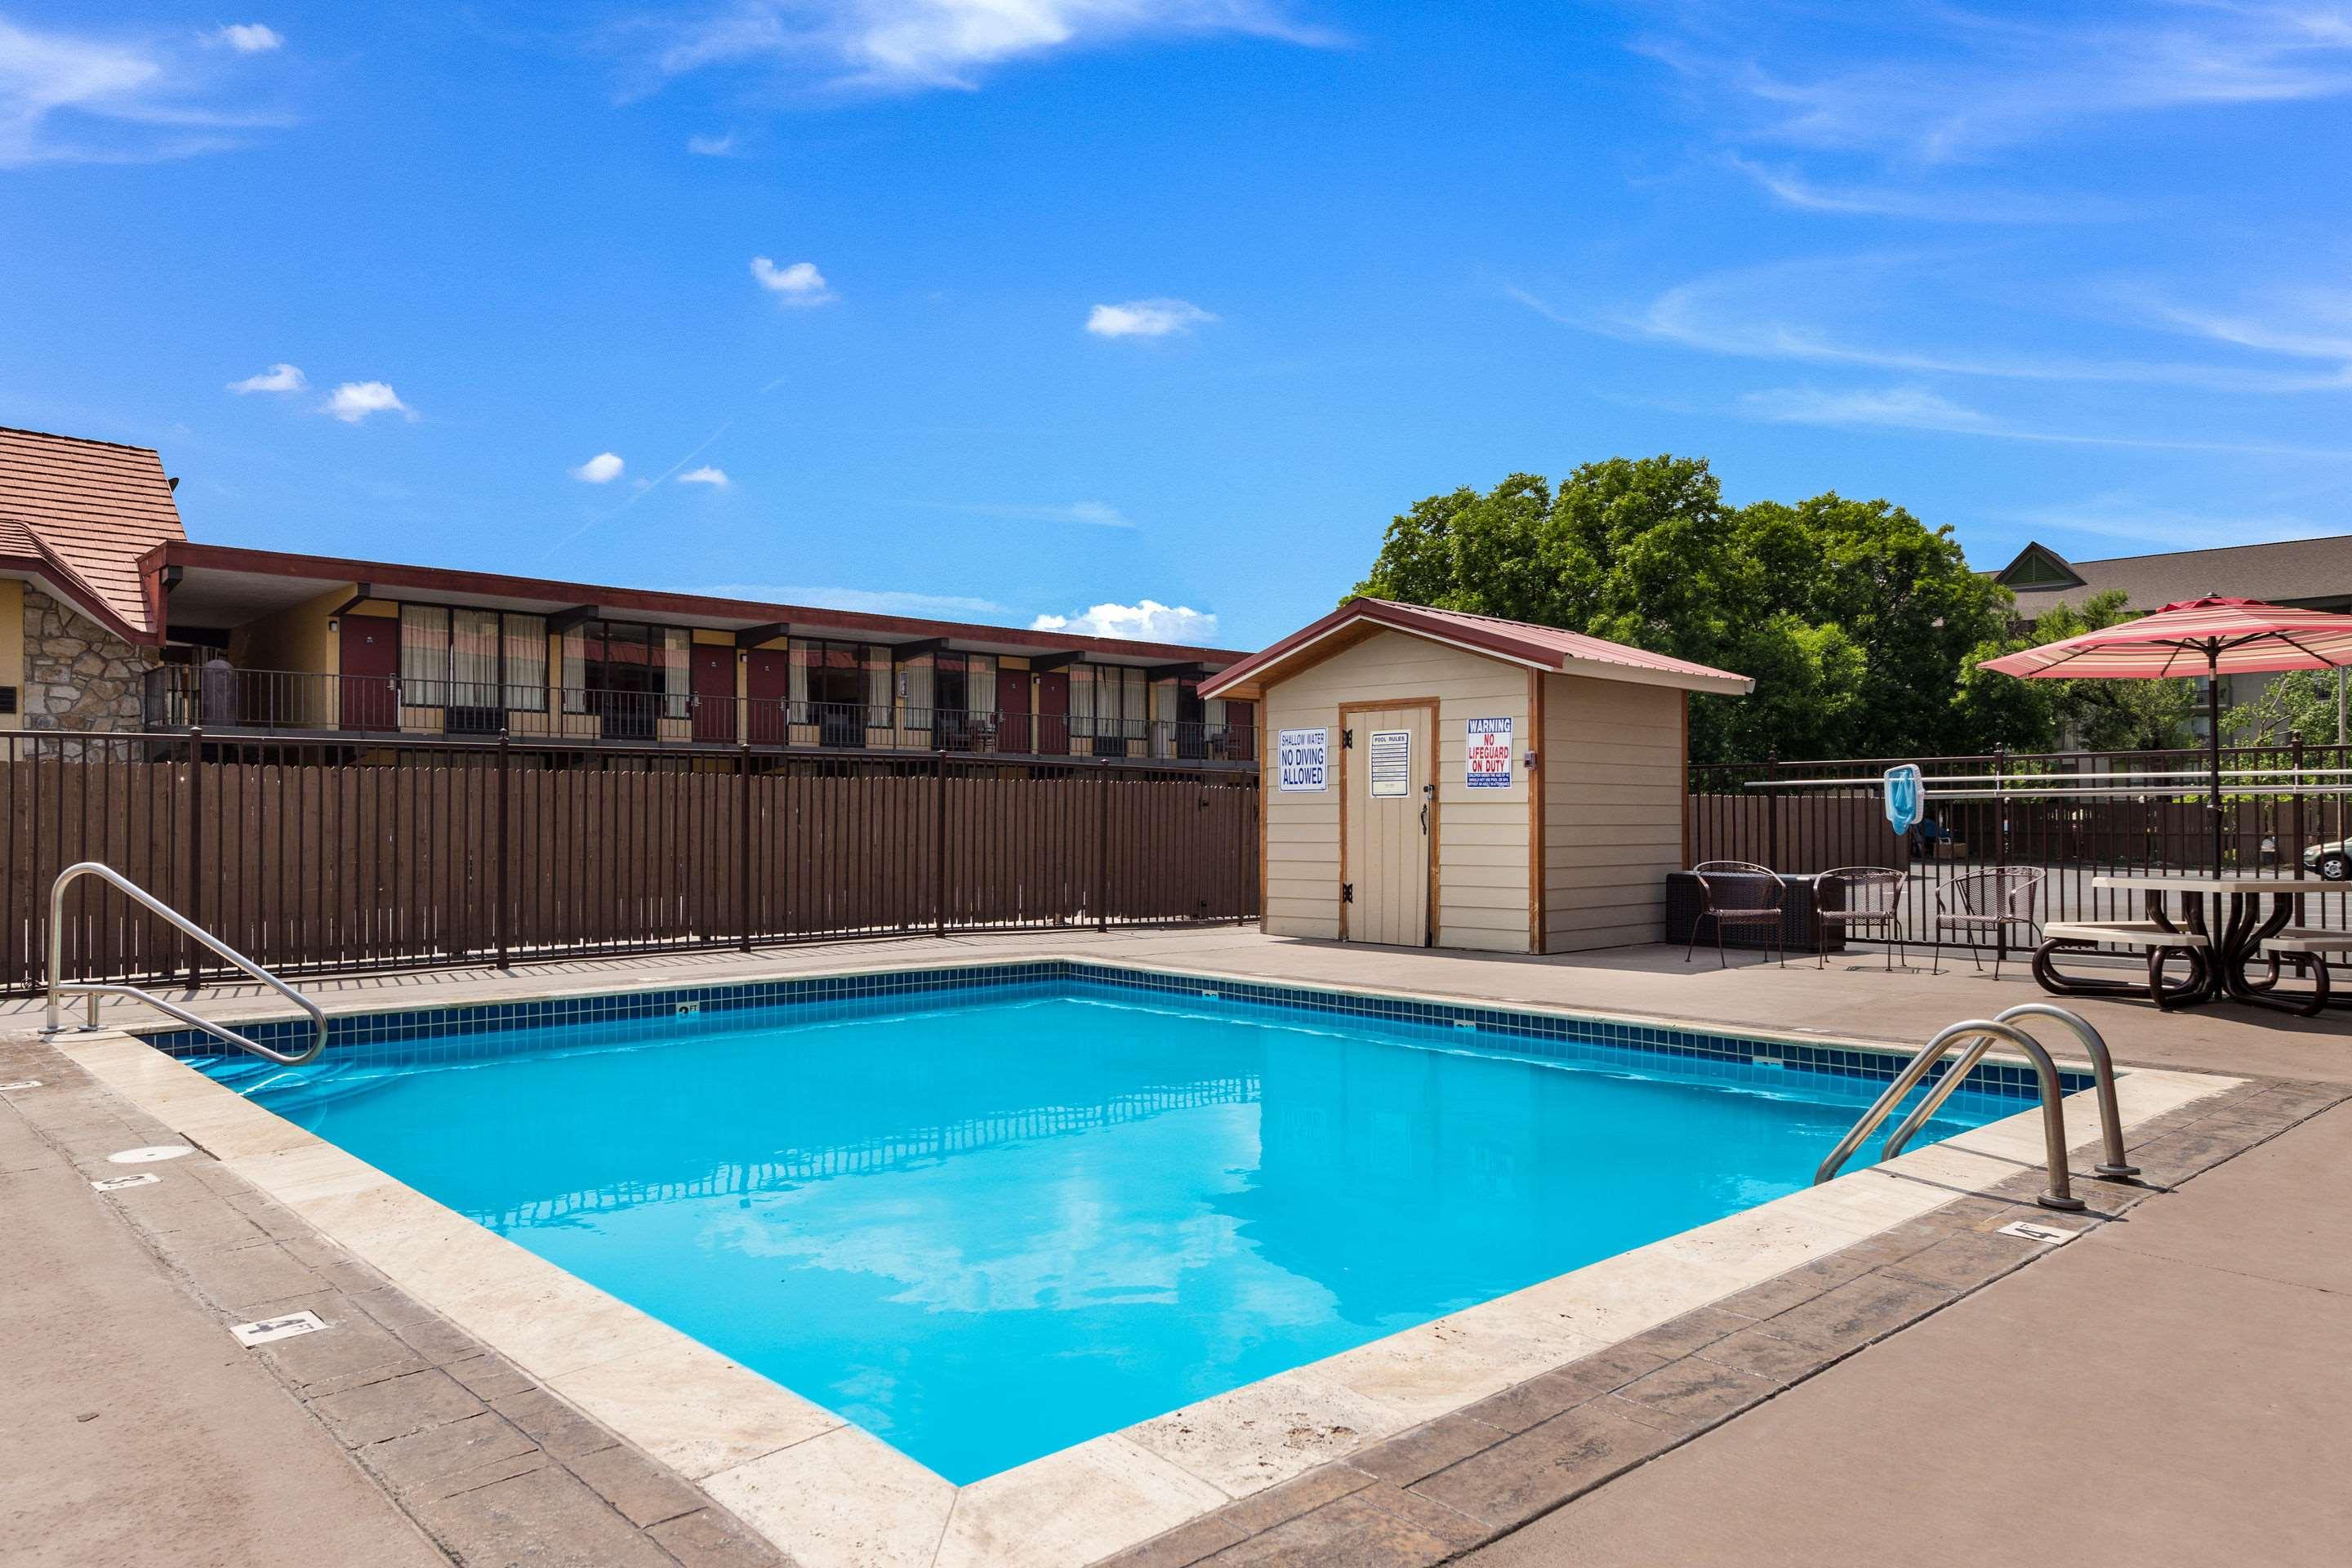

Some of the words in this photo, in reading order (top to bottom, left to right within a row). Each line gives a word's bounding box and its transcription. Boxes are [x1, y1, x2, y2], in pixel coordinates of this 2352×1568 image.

[1470, 719, 1511, 733] WARNING
[1282, 734, 1305, 746] SHALLOW
[1307, 733, 1324, 745] WATER
[1484, 734, 1494, 746] NO
[1282, 749, 1294, 766] NO
[1296, 748, 1324, 765] DIVING
[1469, 746, 1509, 760] LIFEGUARD
[1472, 760, 1482, 772] ON
[1486, 760, 1504, 772] DUTY
[1283, 768, 1323, 785] ALLOWED
